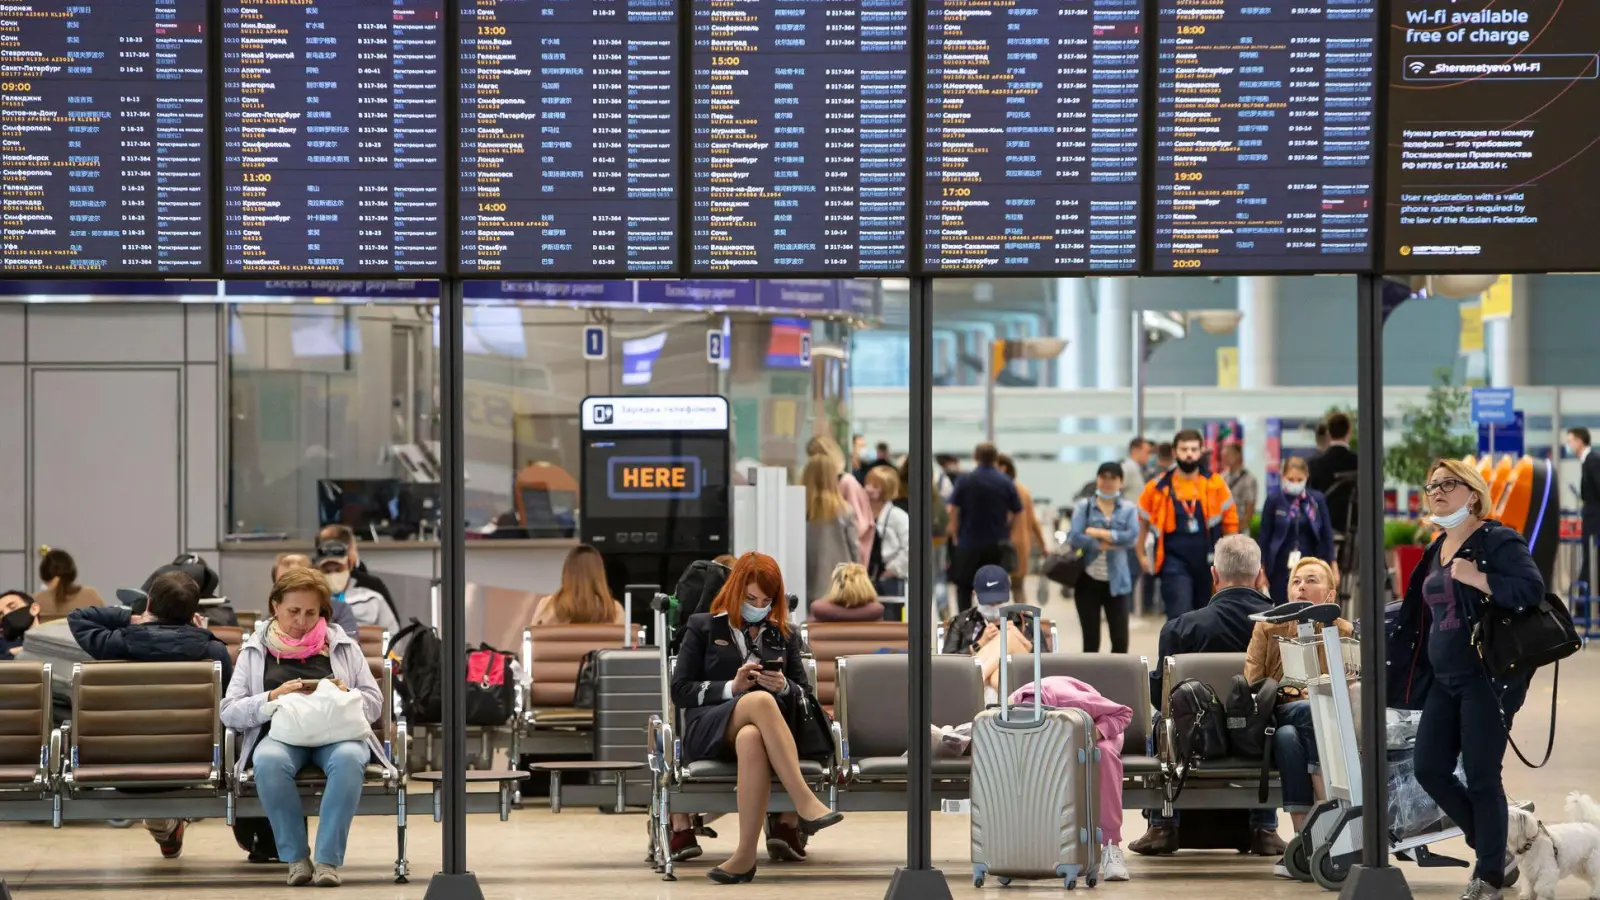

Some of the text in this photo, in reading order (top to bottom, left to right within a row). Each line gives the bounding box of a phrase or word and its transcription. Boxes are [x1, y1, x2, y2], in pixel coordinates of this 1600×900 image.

[1406, 9, 1528, 23] Wi-fi available
[477, 26, 506, 35] 13:00
[1176, 26, 1206, 34] 18:00
[1406, 28, 1530, 44] free of charge
[1, 50, 42, 58] Ставрополь
[711, 56, 740, 66] 15:00
[1, 64, 62, 73] Санкт-Петербург
[1430, 62, 1540, 74] _Sheremetyevo Wi-Fi
[1, 82, 31, 91] 09:00
[2, 94, 42, 102] Геленджик
[2, 110, 58, 118] Ростов-на-Дону
[242, 112, 301, 120] Санкт-Петербург
[2, 124, 52, 133] Симферополь
[242, 126, 296, 135] Ростов-на-Дону
[1402, 130, 1432, 138] Нужна
[1502, 130, 1534, 138] номеру
[242, 141, 291, 150] Симферополь
[1403, 141, 1444, 149] телефона
[1472, 140, 1522, 148] требование
[3, 154, 50, 163] Новосибирск
[1469, 151, 1532, 159] Правительства
[3, 169, 52, 178] Симферополь
[242, 174, 272, 182] 11:00
[1174, 172, 1202, 181] 19:00
[4, 184, 43, 192] Геленджик
[942, 188, 970, 196] 17:00
[4, 198, 42, 207] Краснодар
[1422, 194, 1472, 202] registration
[478, 204, 507, 212] 14:00
[1401, 206, 1429, 214] phone
[1476, 204, 1512, 213] required
[1514, 204, 1526, 213] by
[4, 214, 52, 222] Симферополь
[4, 228, 56, 237] Горно-Алтайск
[4, 244, 18, 252] Уфа
[4, 258, 42, 267] Краснодар
[1173, 259, 1201, 268] 20:00
[591, 332, 598, 350] 1
[711, 337, 720, 355] 2
[622, 467, 686, 488] HERE
